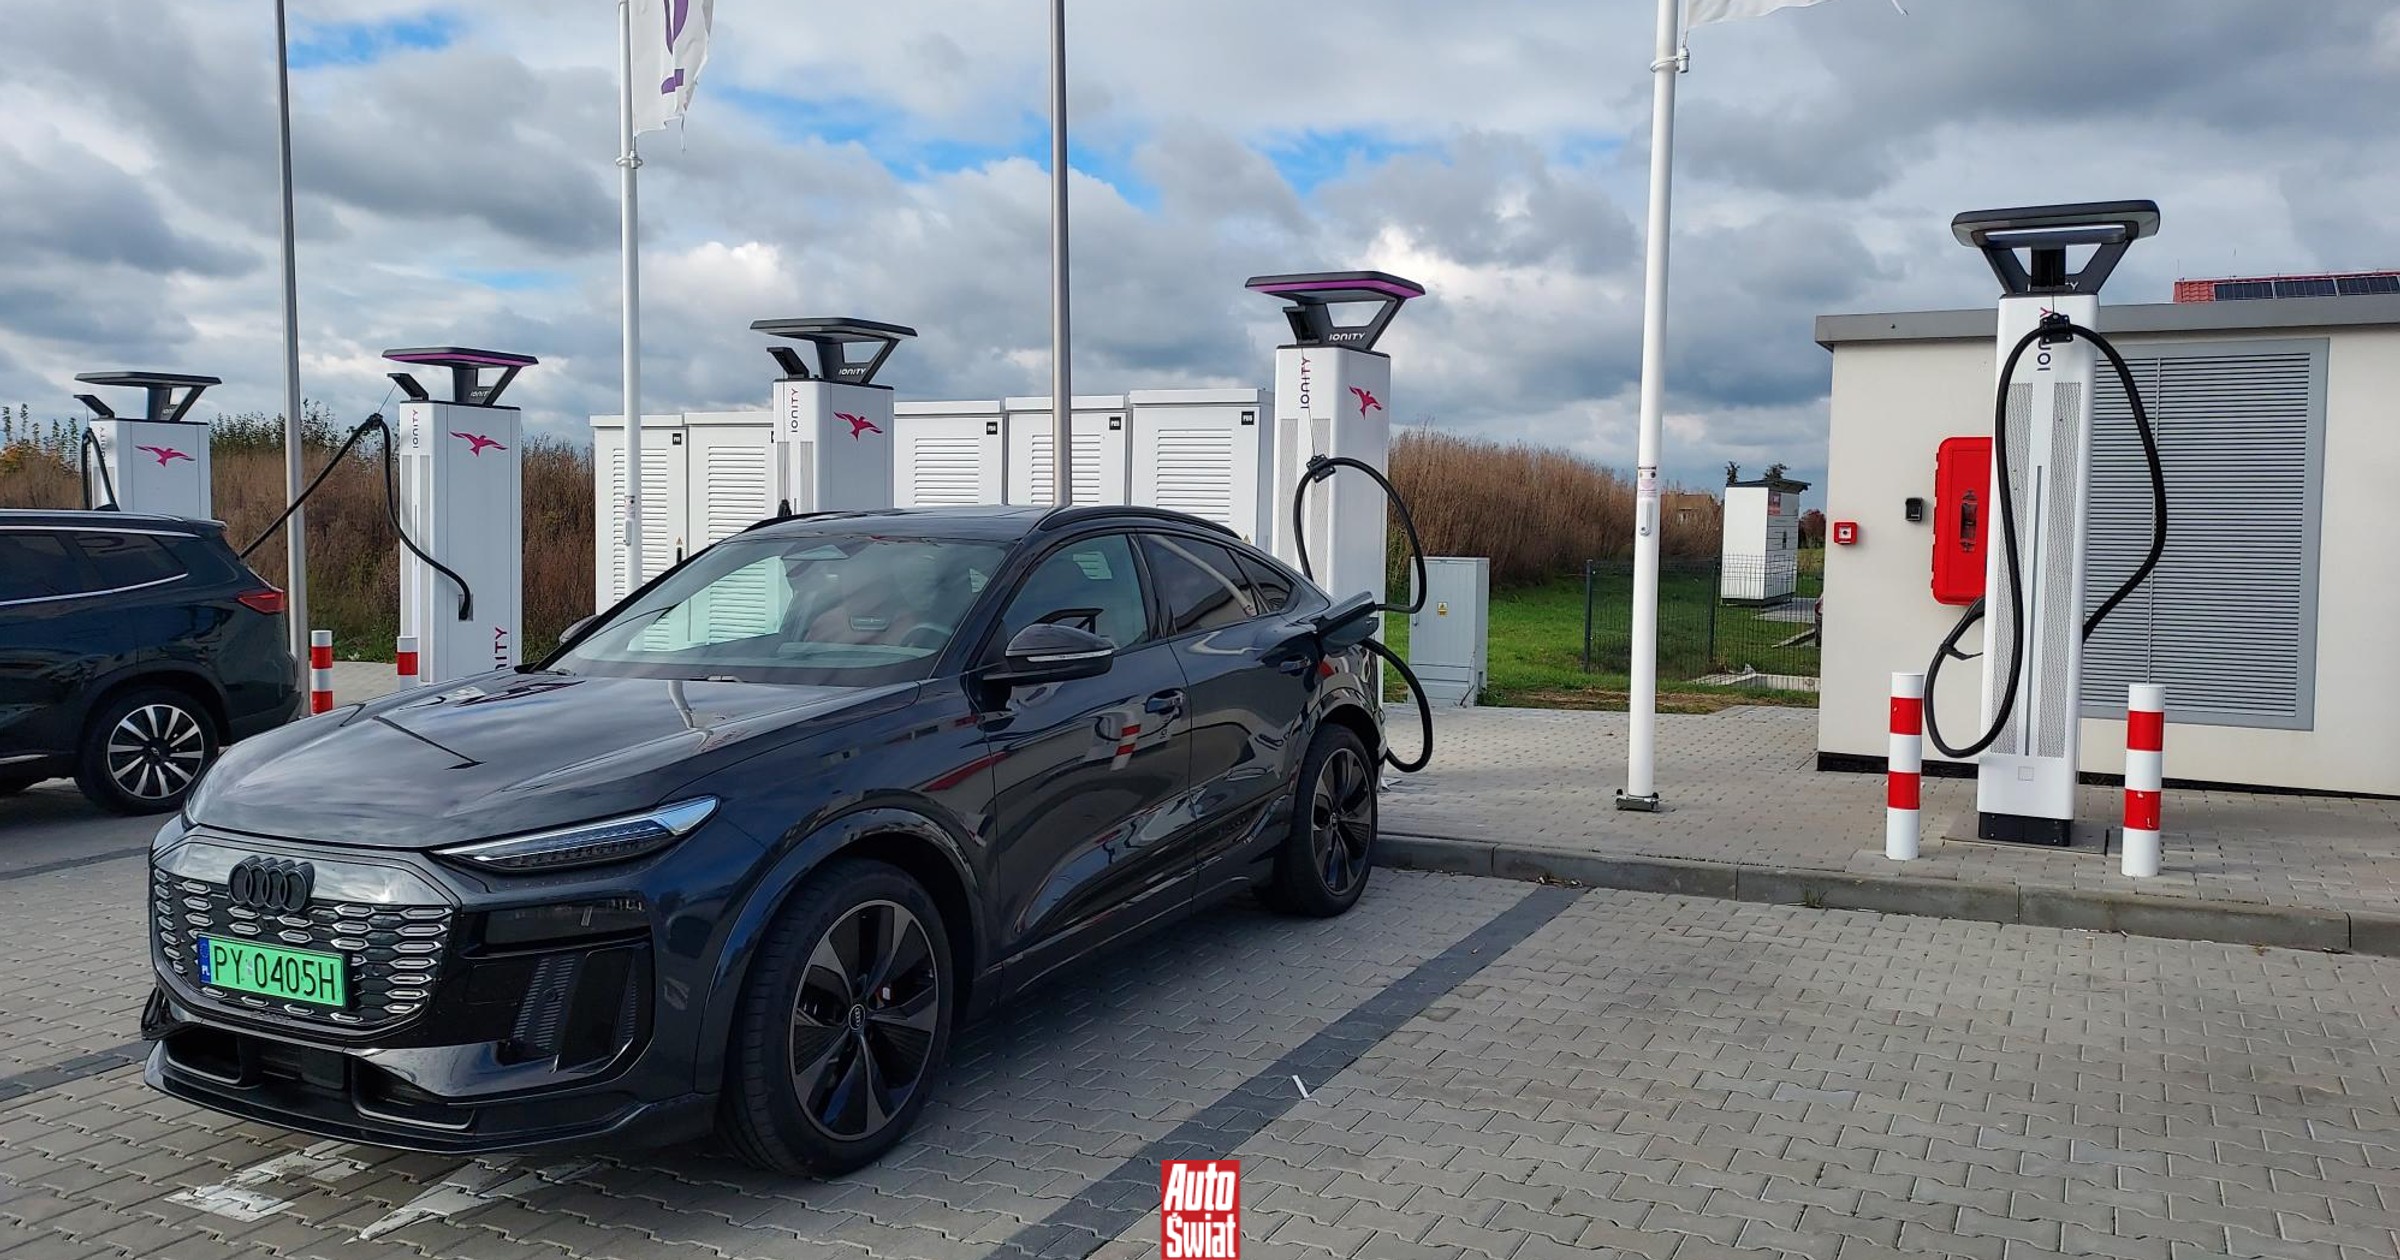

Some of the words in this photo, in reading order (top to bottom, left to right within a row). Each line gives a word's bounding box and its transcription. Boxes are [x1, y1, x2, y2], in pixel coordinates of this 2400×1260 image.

[1328, 331, 1366, 342] IONITY
[2037, 306, 2053, 371] IONY
[838, 367, 867, 375] IONITY
[1300, 356, 1311, 409] IONITY
[790, 387, 799, 433] IONITY
[494, 626, 508, 670] ITY
[201, 964, 211, 976] PL
[213, 945, 243, 985] PY
[254, 952, 336, 1001] 0405H
